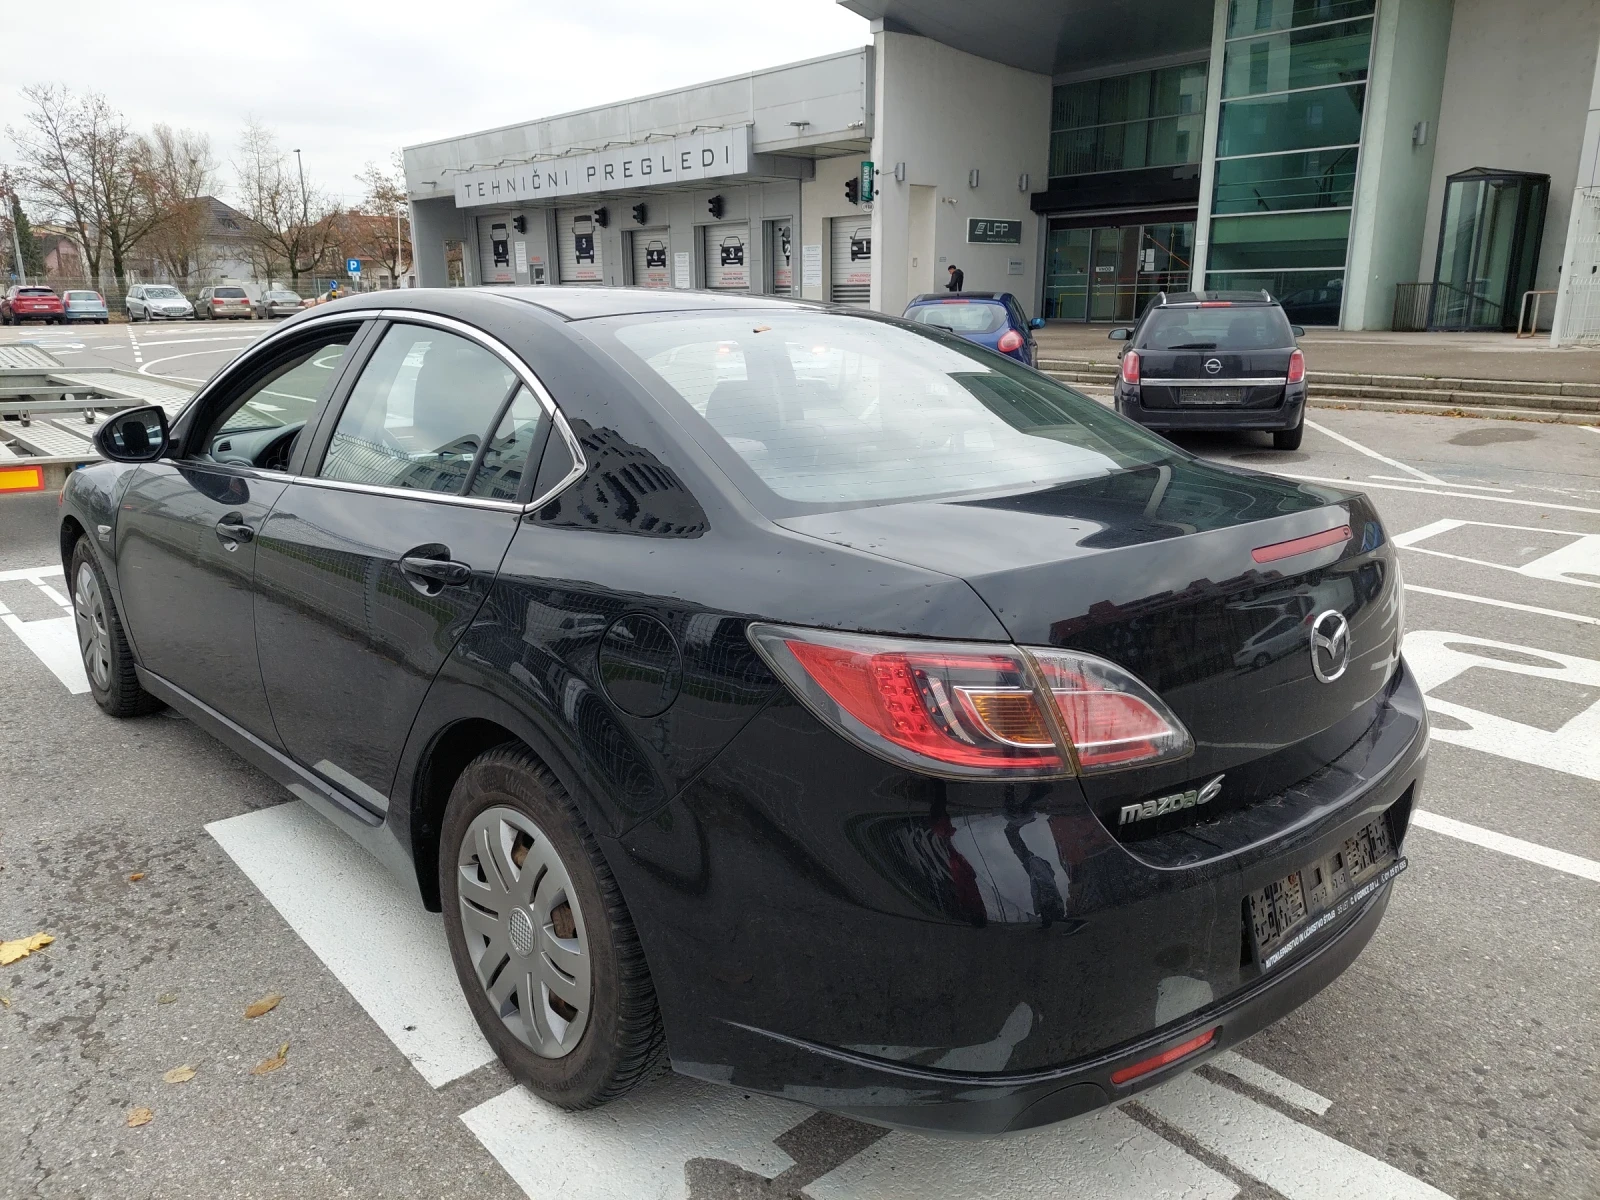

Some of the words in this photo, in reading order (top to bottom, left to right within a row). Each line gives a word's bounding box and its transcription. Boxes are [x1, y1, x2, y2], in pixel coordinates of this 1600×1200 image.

[464, 169, 568, 198] TEHNIČNI
[586, 145, 729, 183] PREGLEDI
[498, 244, 503, 253] 6
[582, 238, 587, 248] 5
[862, 240, 867, 253] 1
[729, 247, 735, 259] 3
[784, 243, 791, 256] 2
[652, 251, 658, 261] 4
[350, 261, 357, 270] P
